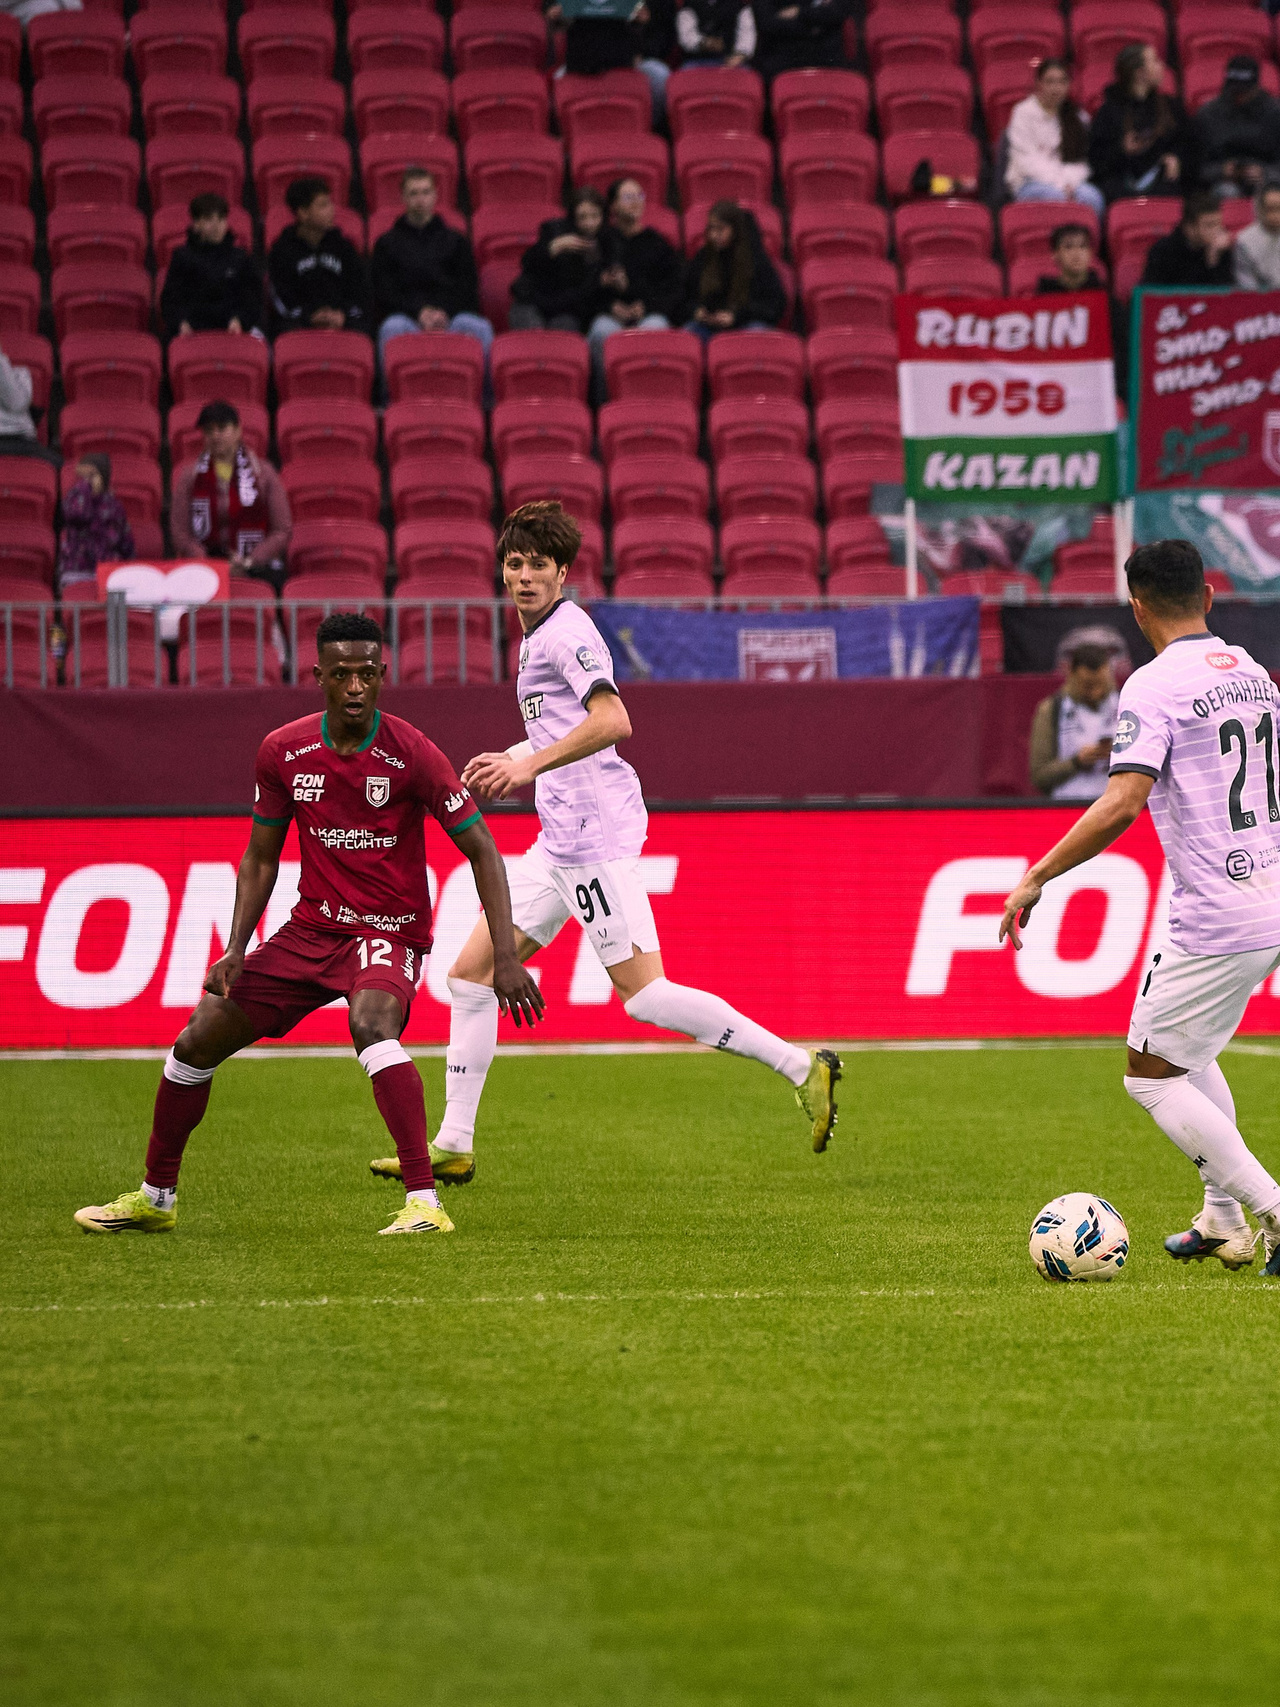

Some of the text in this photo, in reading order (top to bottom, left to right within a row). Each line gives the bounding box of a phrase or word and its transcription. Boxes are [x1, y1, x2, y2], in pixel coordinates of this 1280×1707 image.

[949, 379, 1066, 416] 1958
[923, 451, 1099, 490] KAZAN
[292, 774, 325, 788] FON
[1219, 712, 1280, 832] 21
[293, 788, 325, 802] BET
[317, 828, 375, 839] КАЗАНЬ
[576, 877, 611, 923] 91
[357, 936, 392, 970] 12
